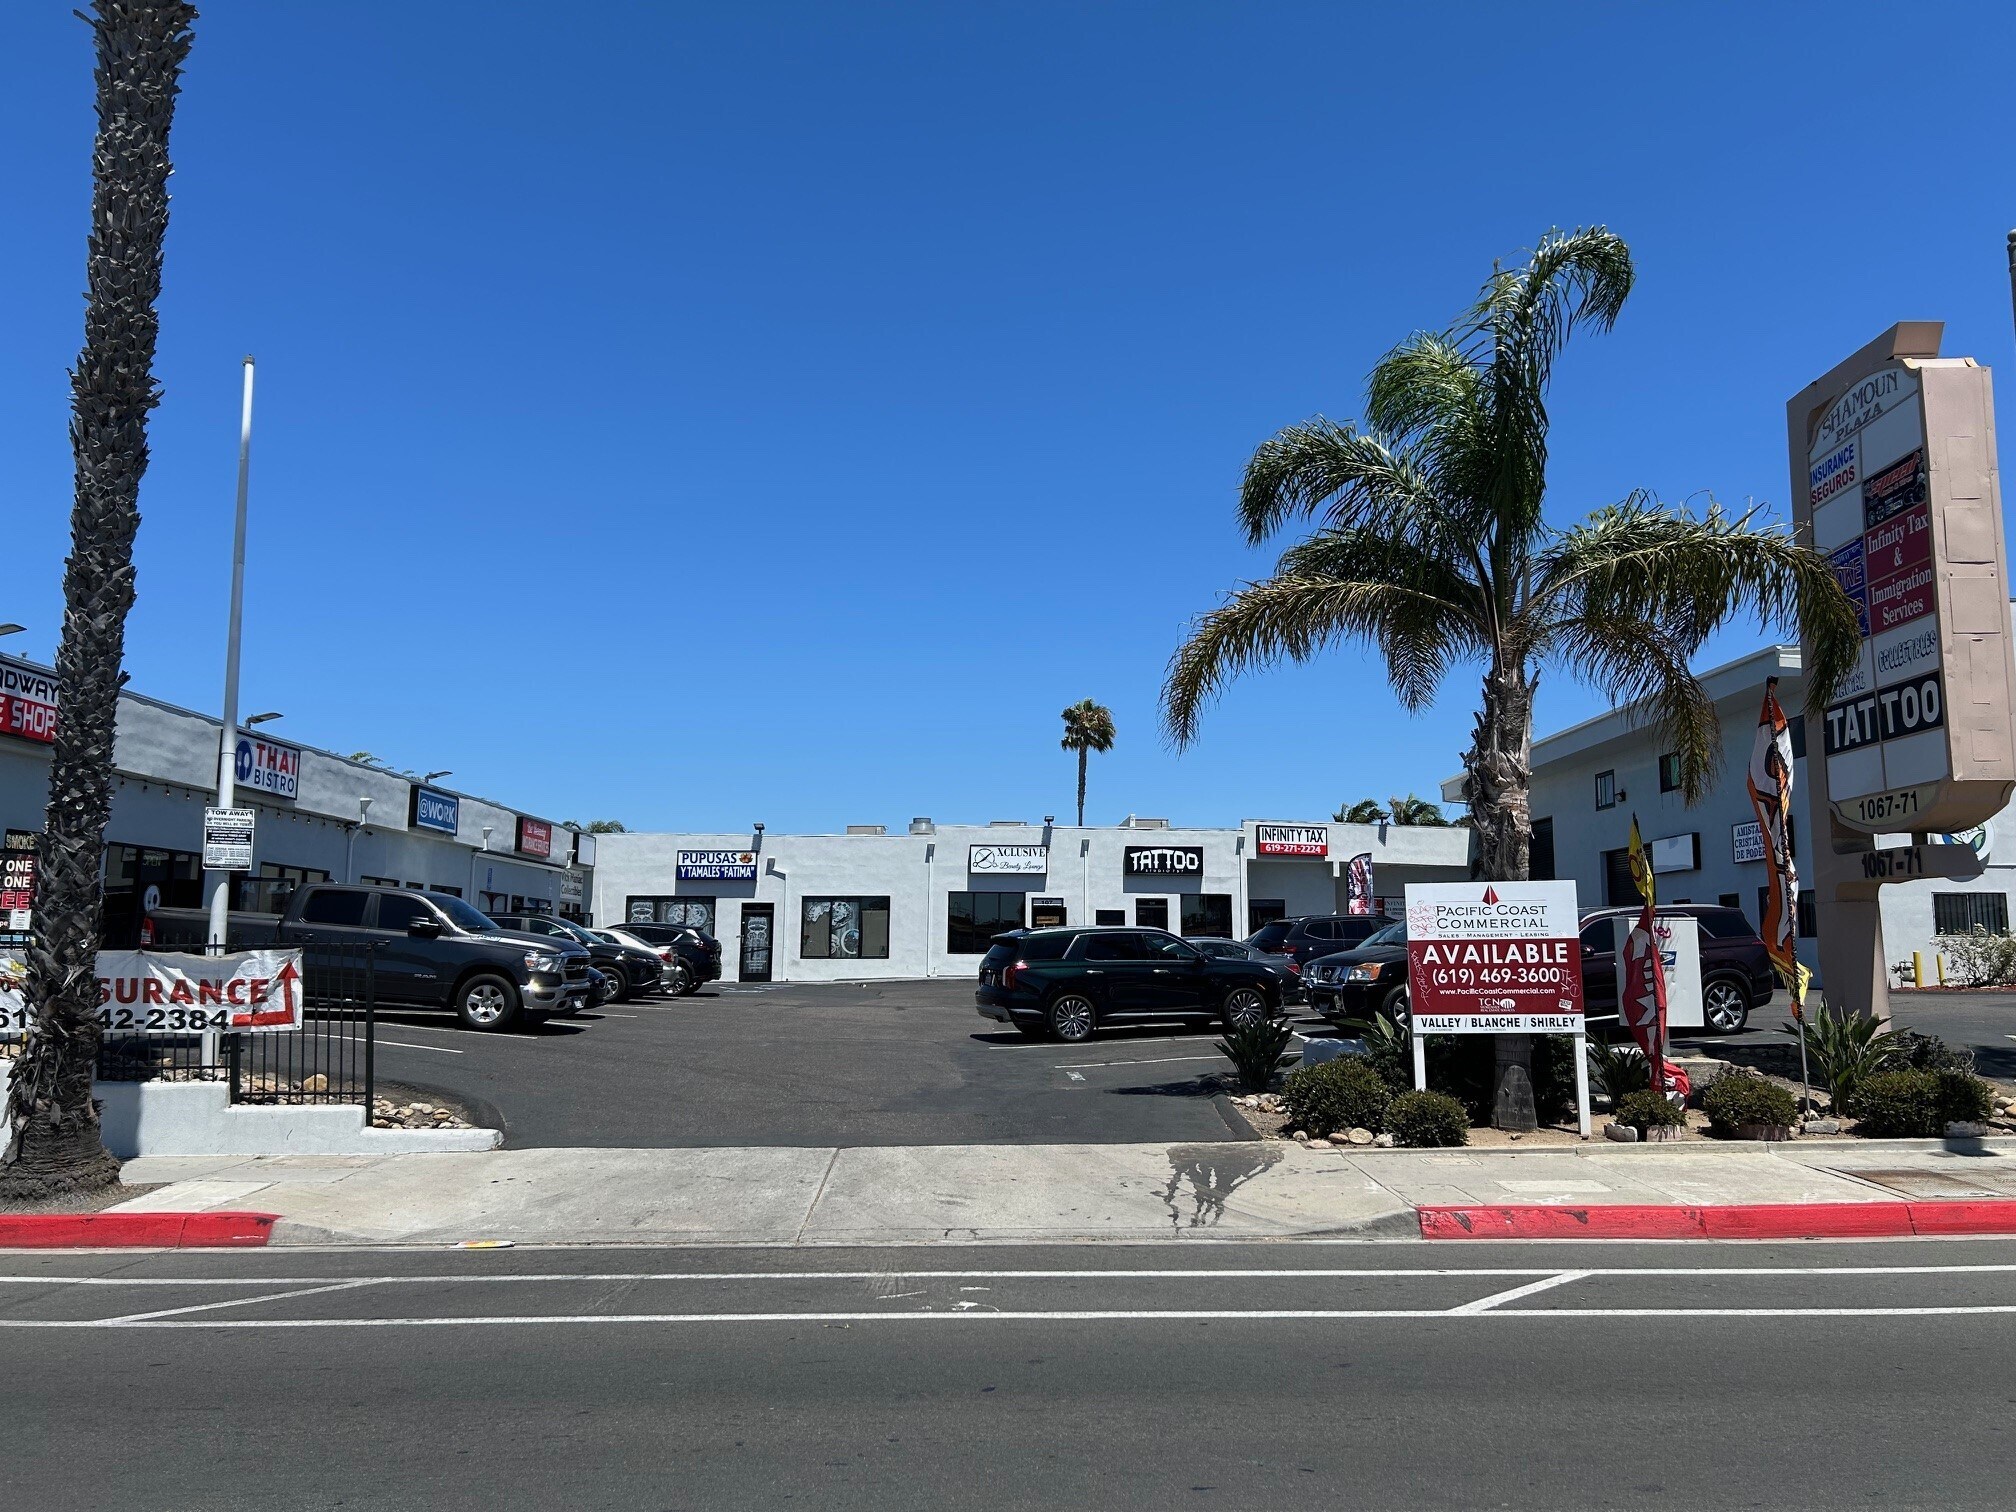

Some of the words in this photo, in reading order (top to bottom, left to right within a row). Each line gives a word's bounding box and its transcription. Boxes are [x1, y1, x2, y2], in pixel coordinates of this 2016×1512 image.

[1822, 371, 1898, 441] SHAMOUN
[1834, 402, 1883, 443] PLAZA
[1811, 444, 1855, 488] INSURANCE
[1811, 465, 1856, 505] SEGUROS
[1867, 524, 1906, 555] Infinity
[1907, 513, 1929, 534] Tax
[1893, 550, 1903, 567] &
[1870, 568, 1933, 607] Immigration
[1882, 596, 1924, 626] Services
[11, 701, 56, 737] SHOP
[1827, 680, 1940, 749] TATTOO
[256, 743, 297, 776] THAI
[254, 769, 295, 793] BISTRO
[419, 798, 455, 824] @WORK
[1858, 790, 1919, 820] 1067-71
[1261, 827, 1303, 842] INFINITY
[1305, 829, 1324, 843] TAX
[1736, 824, 1761, 837] AMISTA
[1265, 844, 1321, 853] 619-271-2224
[1735, 836, 1763, 849] CRISTIAN
[681, 852, 737, 864] PUPUSAS
[997, 847, 1045, 857] XCLUSIVE
[1130, 849, 1199, 871] TATTOO
[1736, 849, 1745, 860] DE
[6, 860, 33, 872] ONE
[680, 866, 687, 877] Y
[688, 865, 720, 878] TAMALES
[4, 876, 31, 888] ONE
[1, 891, 30, 910] EE
[1436, 905, 1492, 916] PACIFIC
[1496, 904, 1548, 916] COAST
[1437, 917, 1549, 929] COMMERCIAL
[1422, 943, 1568, 965] AVAILABLE
[1433, 968, 1475, 986] (619)
[1480, 968, 1560, 983] 469-3600
[1439, 987, 1556, 995] www.PacificCoastCommercial.com
[1478, 998, 1500, 1006] TCN
[1421, 1018, 1461, 1027] VALLEY
[1471, 1018, 1520, 1028] BLANCHE
[1530, 1017, 1576, 1027] SHIRLEY
